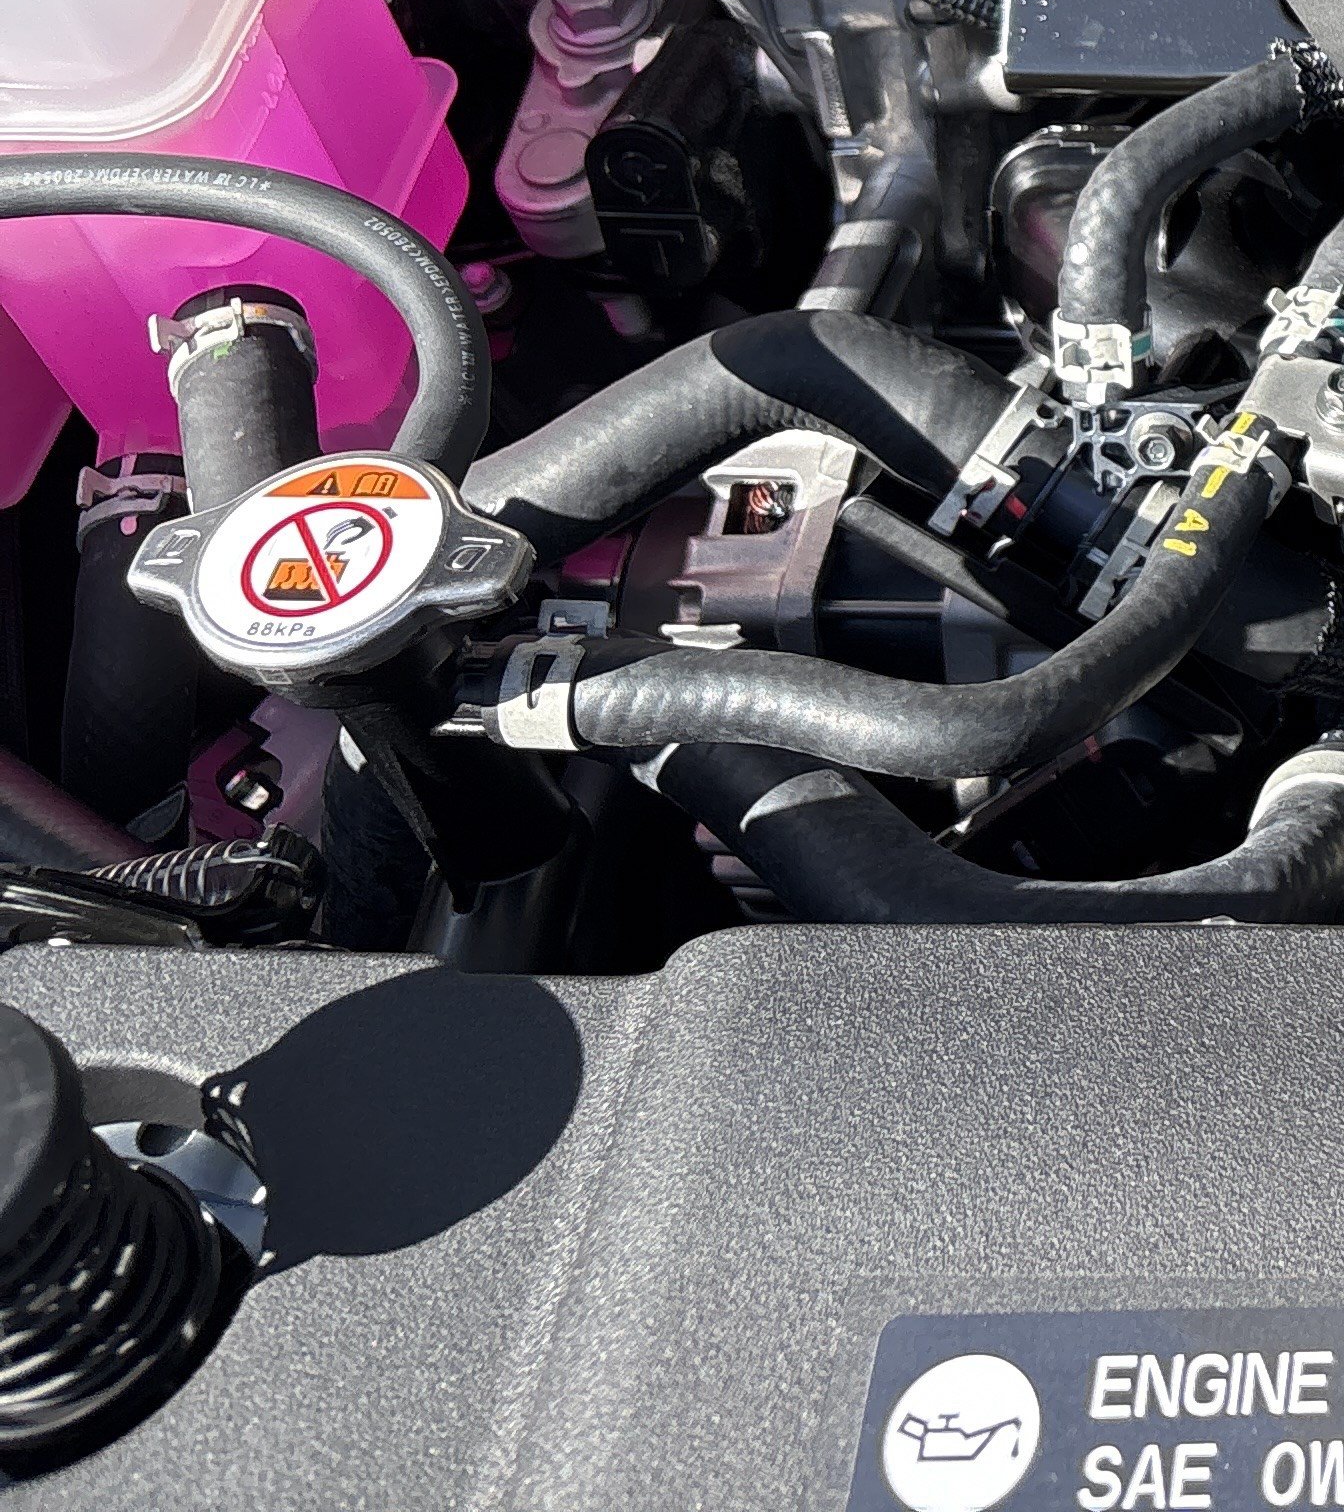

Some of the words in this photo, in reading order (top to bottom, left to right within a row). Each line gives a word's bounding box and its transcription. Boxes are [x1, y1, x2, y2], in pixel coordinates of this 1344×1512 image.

[246, 621, 317, 638] 88kPa
[1089, 1349, 1334, 1420] ENGINE
[1078, 1443, 1217, 1511] SAE
